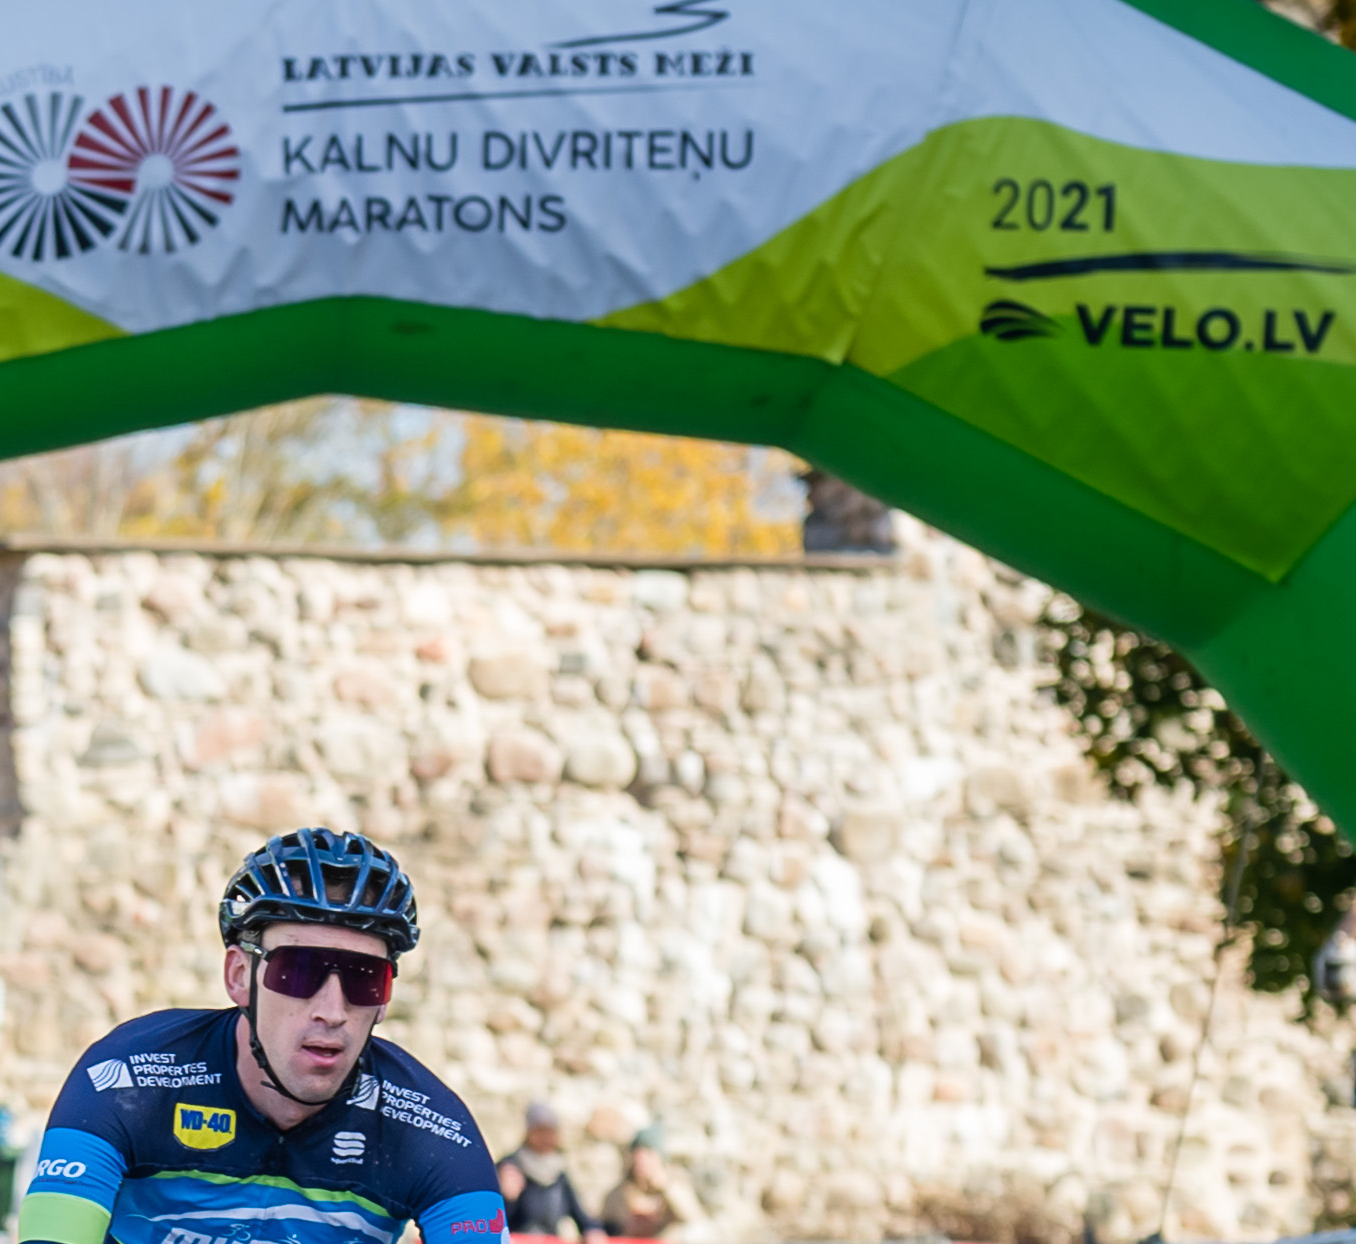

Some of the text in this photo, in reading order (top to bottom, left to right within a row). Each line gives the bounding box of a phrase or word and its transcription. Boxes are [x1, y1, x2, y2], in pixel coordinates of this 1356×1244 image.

[282, 47, 756, 82] LATVIJAS VALSTS MEŽI
[283, 130, 754, 181] KALNU DIVRITEŅU
[281, 195, 567, 234] MARATONS
[990, 177, 1118, 233] 2021
[1075, 304, 1336, 354] VELO.LV
[129, 1053, 177, 1065] INVEST
[133, 1062, 207, 1076] PROPERTES
[382, 1079, 430, 1104] INVEST
[180, 1108, 232, 1134] WD-40
[379, 1105, 472, 1148] EVELOPMENT
[34, 1158, 87, 1178] RGO
